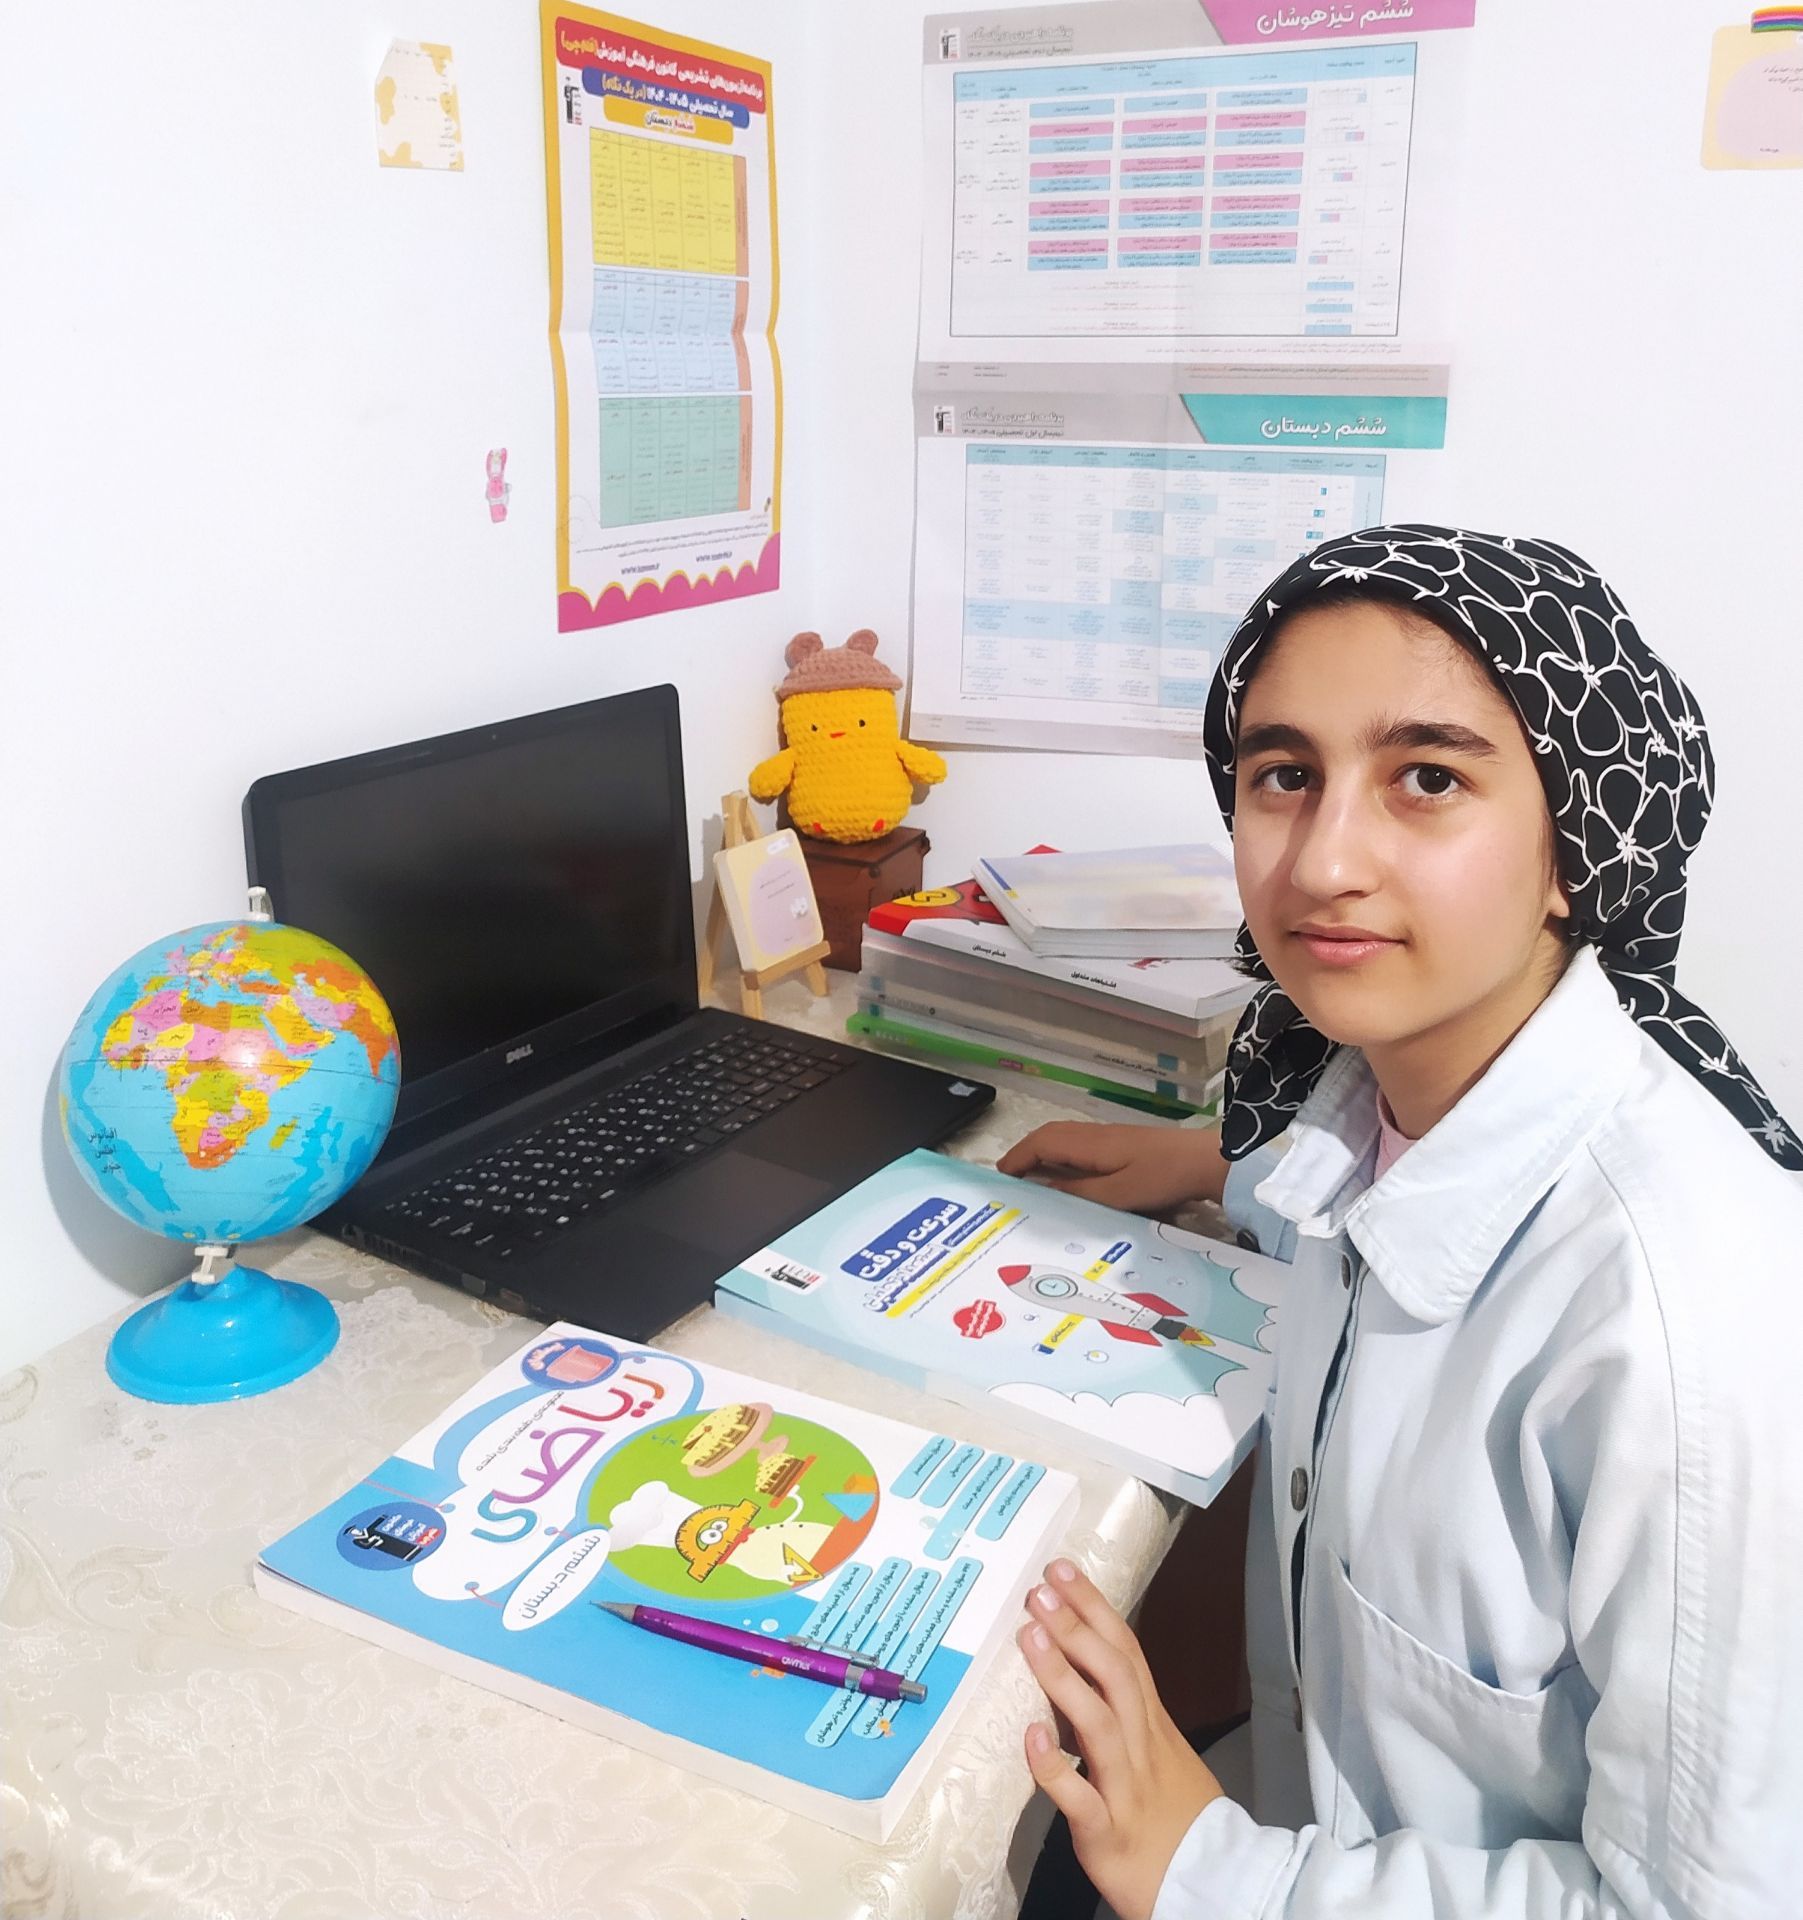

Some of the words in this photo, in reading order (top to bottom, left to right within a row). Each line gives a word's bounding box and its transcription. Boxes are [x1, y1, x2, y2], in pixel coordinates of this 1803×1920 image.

[1257, 5, 1354, 35] تیزهوشان
[1360, 0, 1414, 28] ششم
[1260, 417, 1331, 439] دبستان
[1334, 417, 1387, 441] ششم
[505, 1043, 535, 1065] DELL
[906, 1201, 961, 1241] سرعت
[901, 1240, 917, 1256] و
[858, 1248, 903, 1279] دقت
[470, 1372, 666, 1543] ریاضی
[567, 1535, 601, 1577] ششم
[521, 1573, 567, 1620] دبستان
